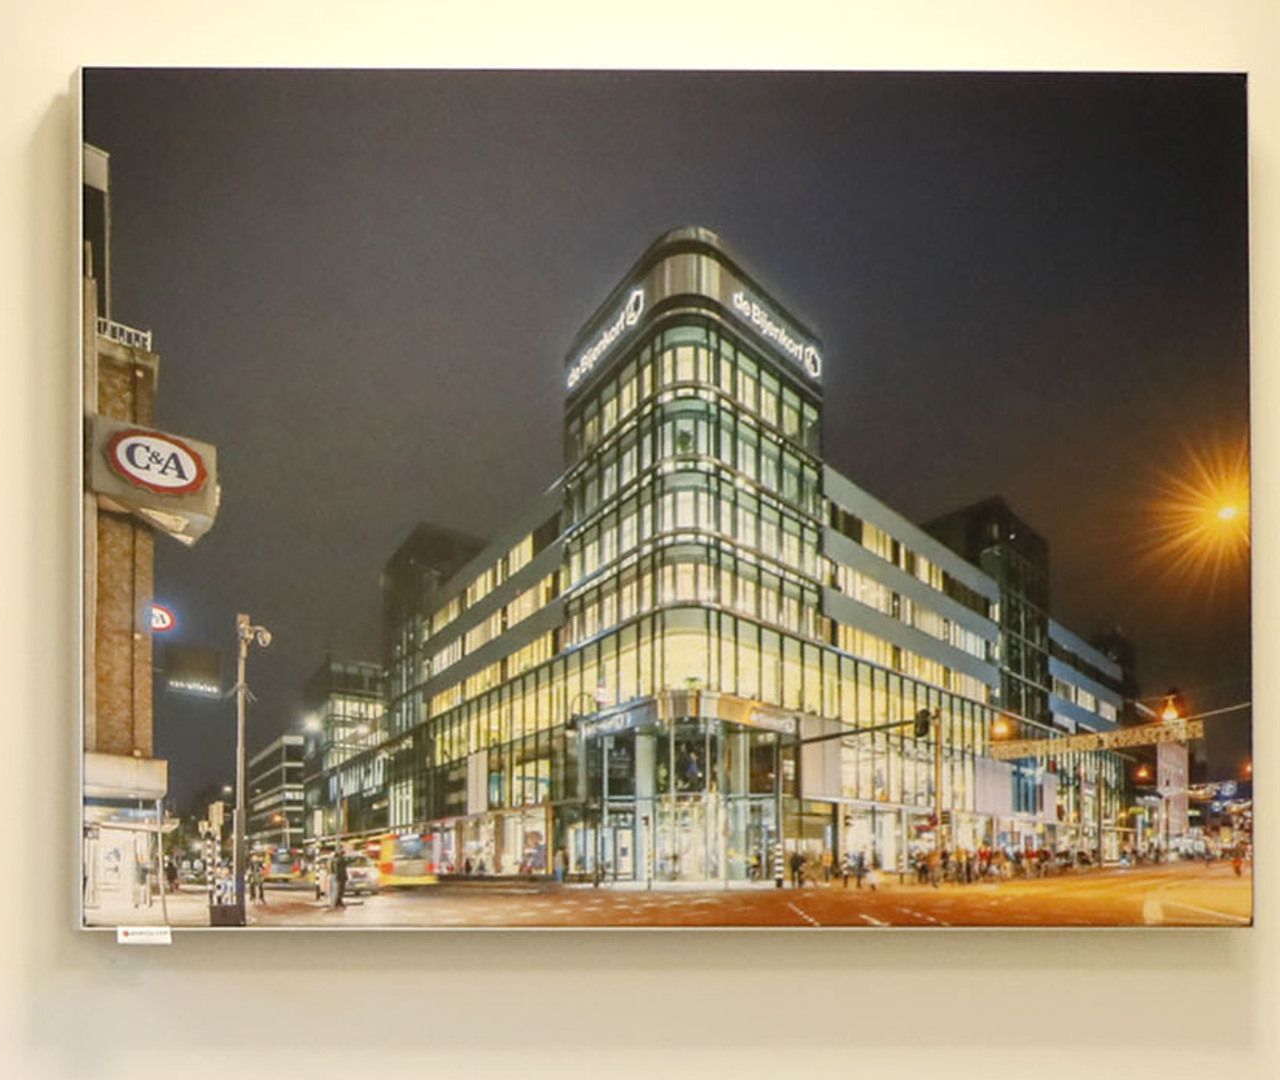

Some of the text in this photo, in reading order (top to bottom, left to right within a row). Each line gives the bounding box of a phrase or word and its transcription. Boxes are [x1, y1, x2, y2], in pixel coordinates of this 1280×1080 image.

[733, 292, 803, 361] de Bijenkorf
[125, 442, 189, 481] C&A
